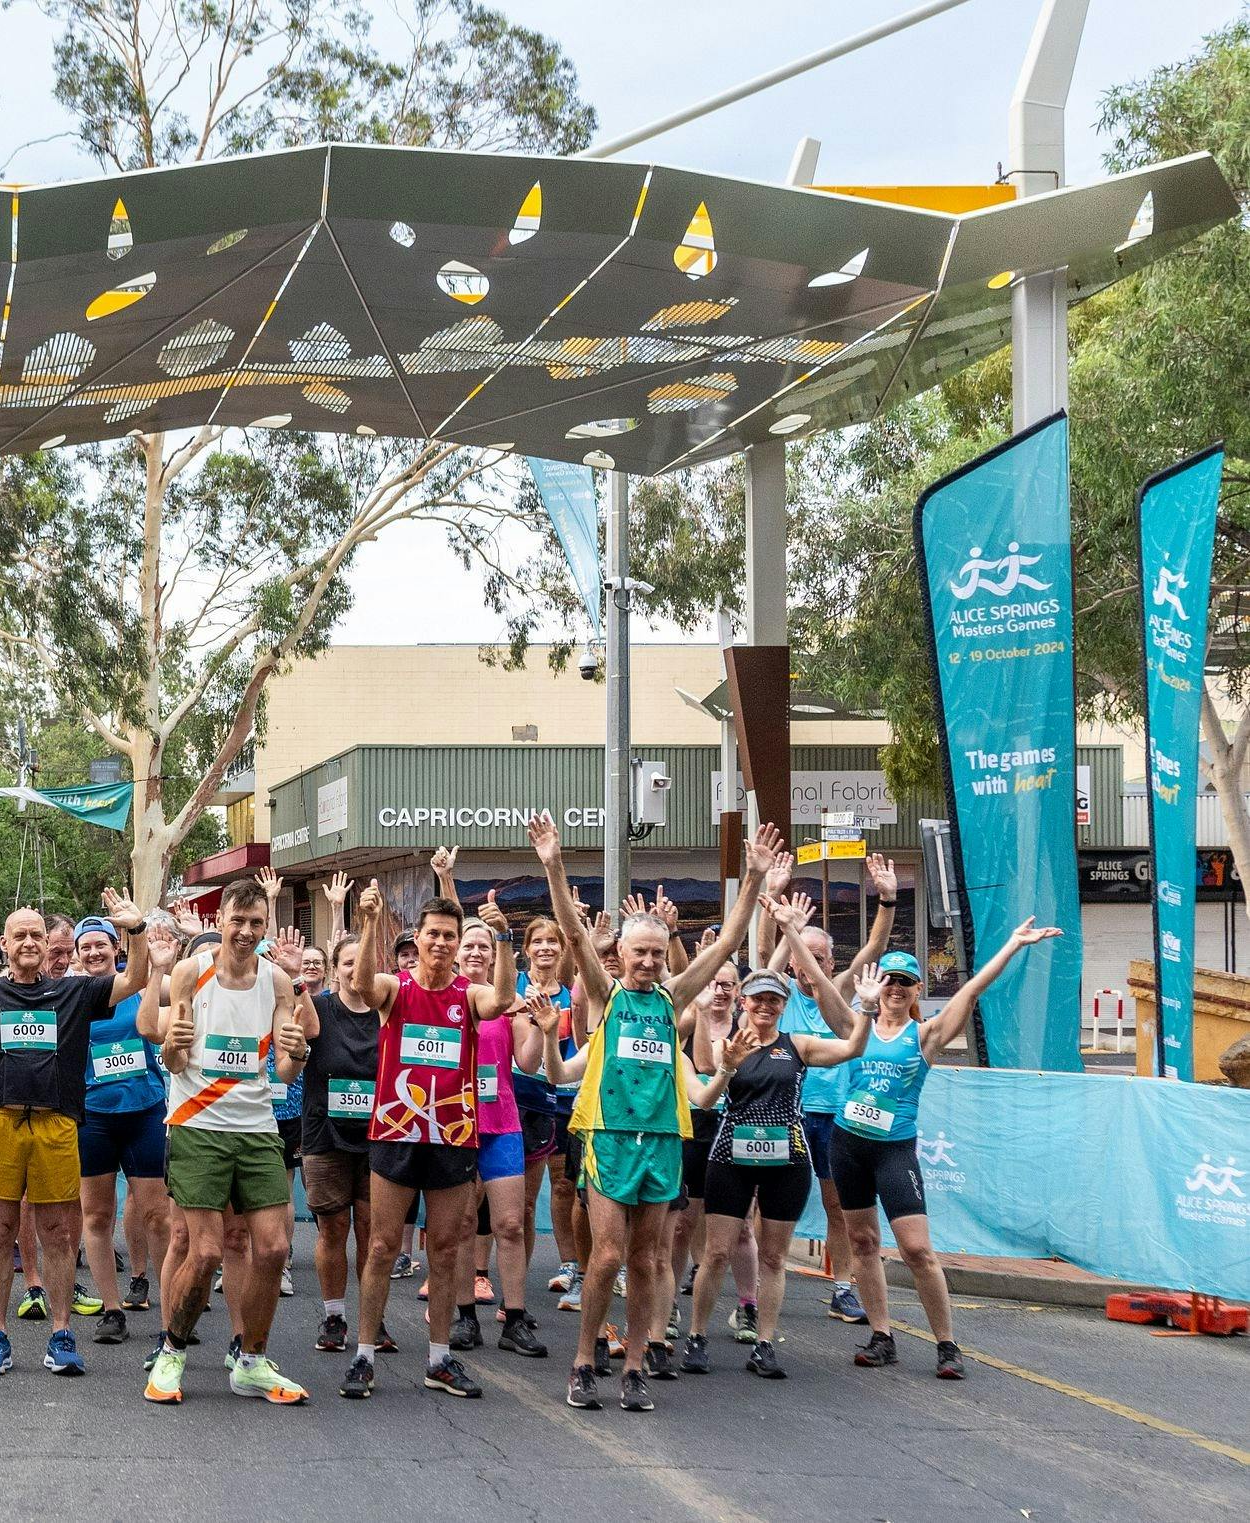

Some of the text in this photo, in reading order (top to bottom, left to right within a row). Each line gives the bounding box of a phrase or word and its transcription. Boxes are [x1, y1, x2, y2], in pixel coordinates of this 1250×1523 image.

[949, 598, 1061, 625] ALICE SPRINGS
[952, 617, 1056, 639] Masters Games
[949, 653, 961, 664] 12
[969, 651, 983, 662] 19
[985, 647, 1031, 662] October
[1034, 641, 1065, 656] 2024
[965, 747, 1057, 773] The games
[971, 774, 1009, 797] with
[1097, 860, 1123, 871] ALICE
[1090, 870, 1130, 881] SPRINGS
[13, 1024, 45, 1036] 6009
[418, 1040, 446, 1054] 6011
[632, 1039, 664, 1056] 6504
[104, 1053, 135, 1069] 3006
[218, 1052, 248, 1066] 4014
[861, 1060, 904, 1079] MORRIS
[868, 1077, 891, 1093] AUS
[340, 1093, 369, 1106] 3504
[853, 1103, 881, 1121] 5503
[746, 1141, 776, 1154] 6001
[925, 1168, 967, 1184] SPRINGS
